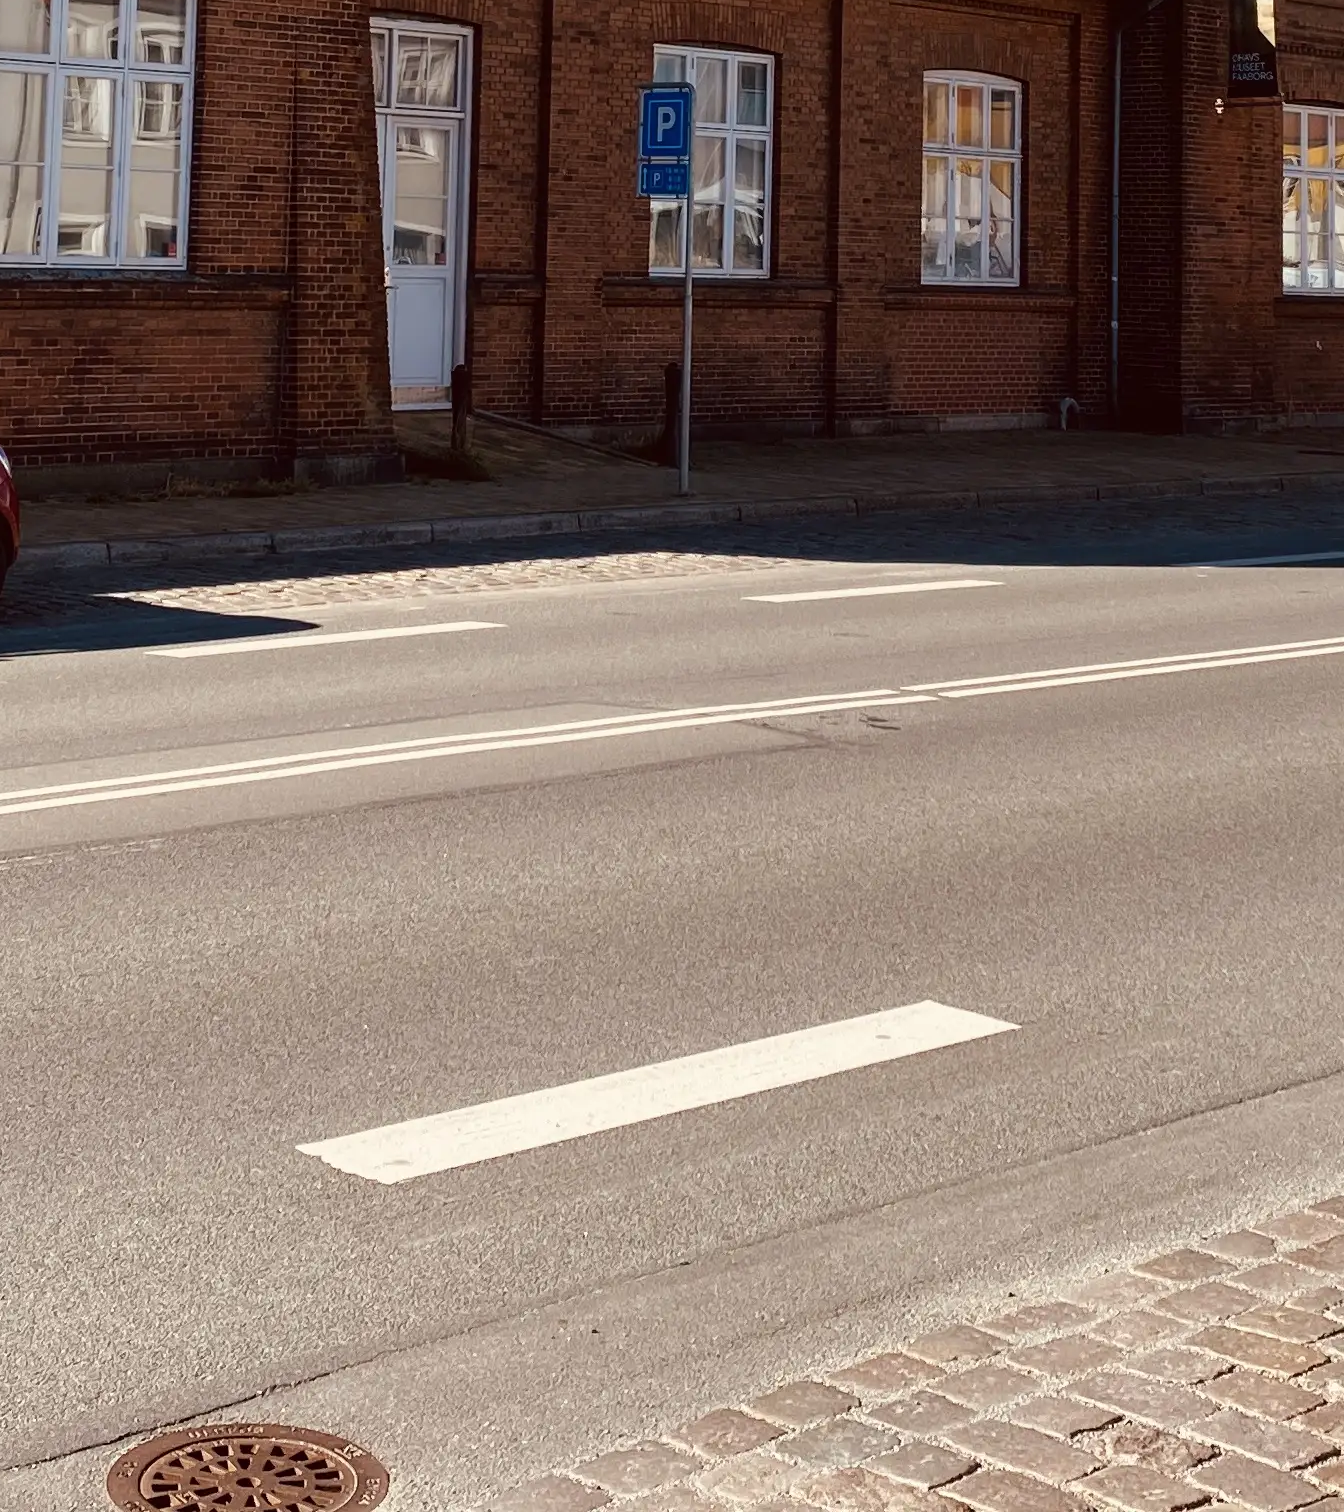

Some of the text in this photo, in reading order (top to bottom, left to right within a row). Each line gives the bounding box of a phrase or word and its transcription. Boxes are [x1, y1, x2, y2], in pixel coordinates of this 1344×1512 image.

[1232, 62, 1265, 72] MUSEET
[1232, 71, 1274, 81] FAABORG
[657, 106, 676, 142] P
[653, 172, 661, 186] P
